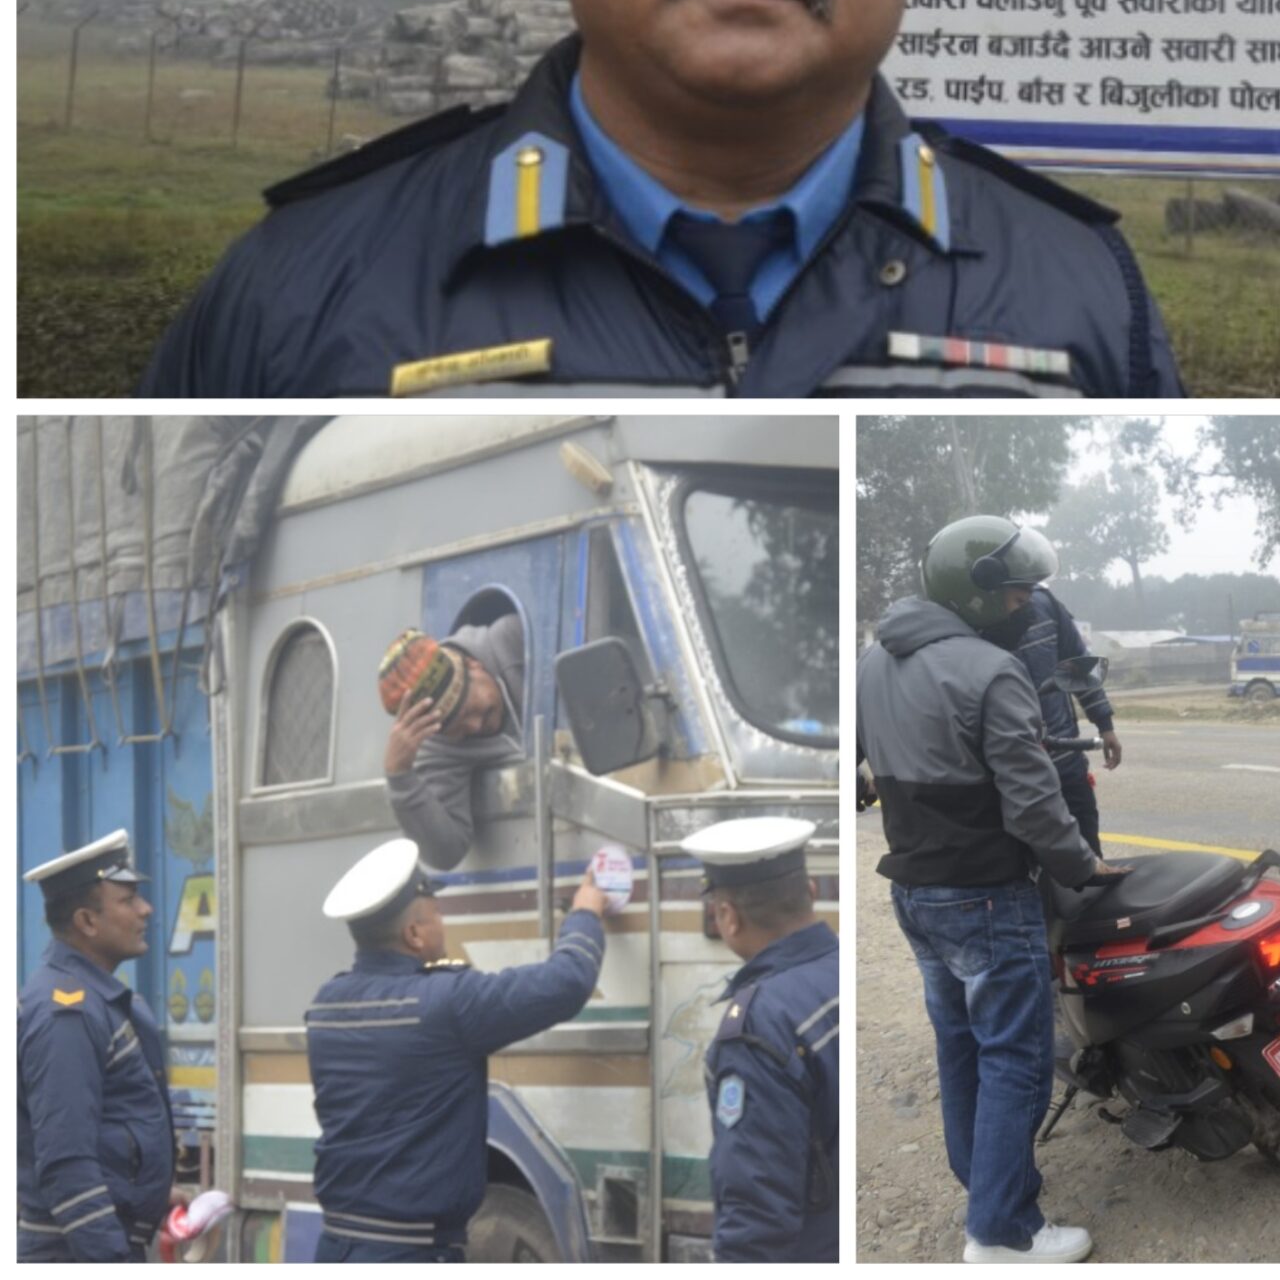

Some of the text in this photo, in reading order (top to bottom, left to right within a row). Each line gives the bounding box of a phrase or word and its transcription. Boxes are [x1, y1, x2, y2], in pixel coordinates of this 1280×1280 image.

[897, 30, 978, 59] साईरन
[1080, 33, 1151, 63] आउने
[1162, 34, 1236, 65] सवारी
[1075, 80, 1090, 105] र
[1101, 78, 1219, 114] बिजुलीका
